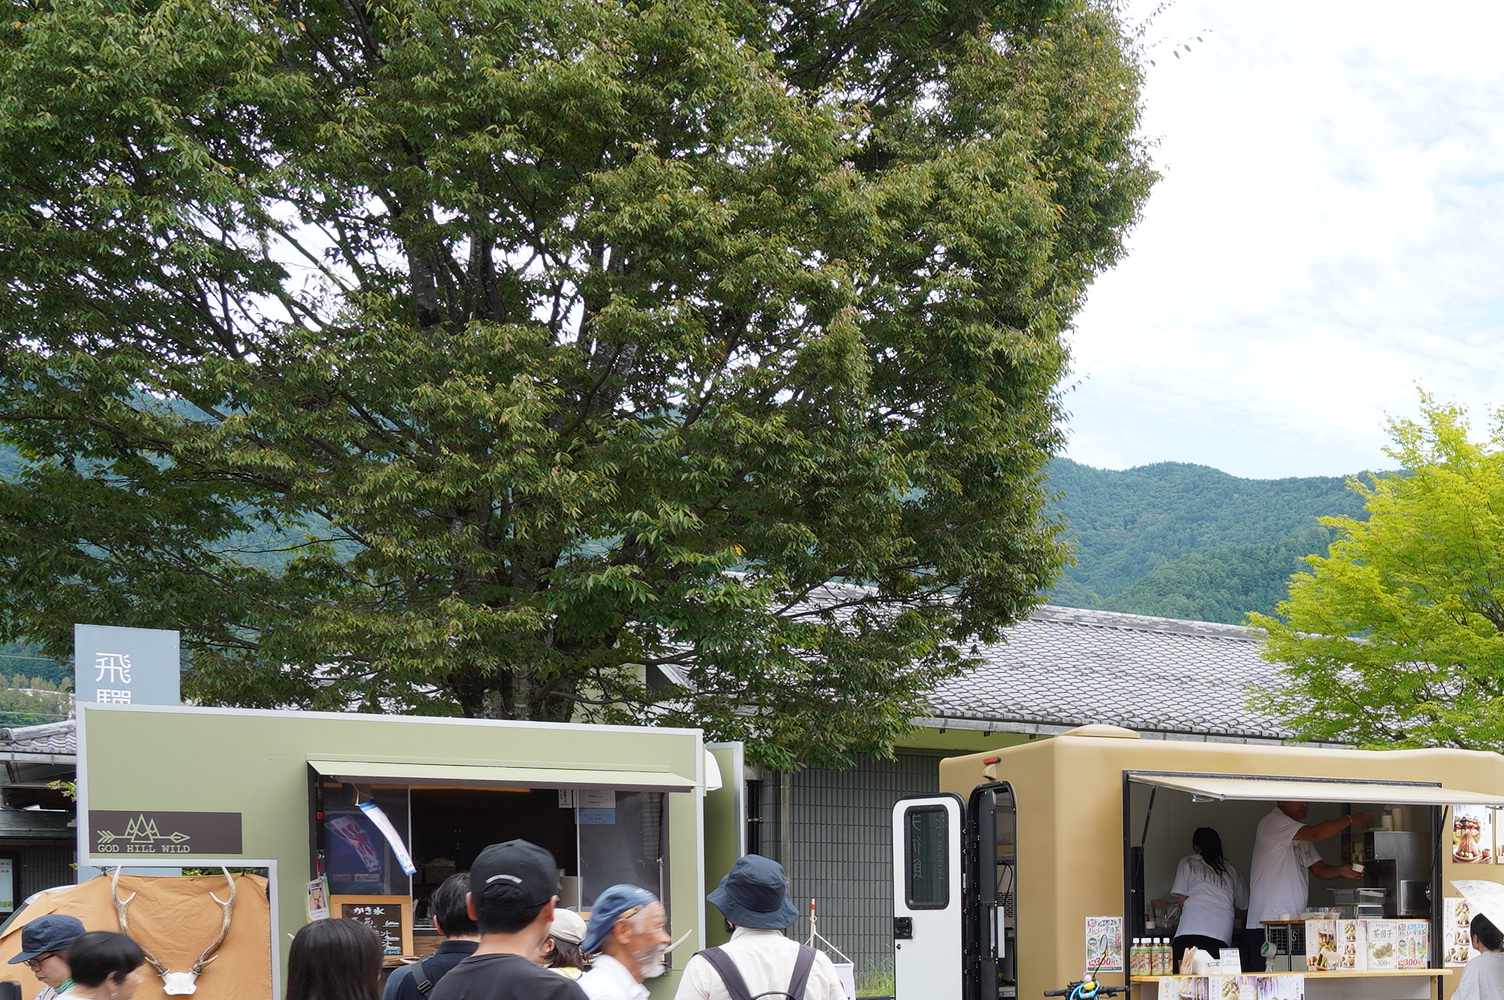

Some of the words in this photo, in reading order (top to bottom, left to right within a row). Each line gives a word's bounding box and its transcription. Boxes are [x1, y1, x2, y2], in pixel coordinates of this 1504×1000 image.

[97, 844, 120, 853] GOD
[126, 844, 155, 853] HILL
[161, 844, 190, 853] WILD
